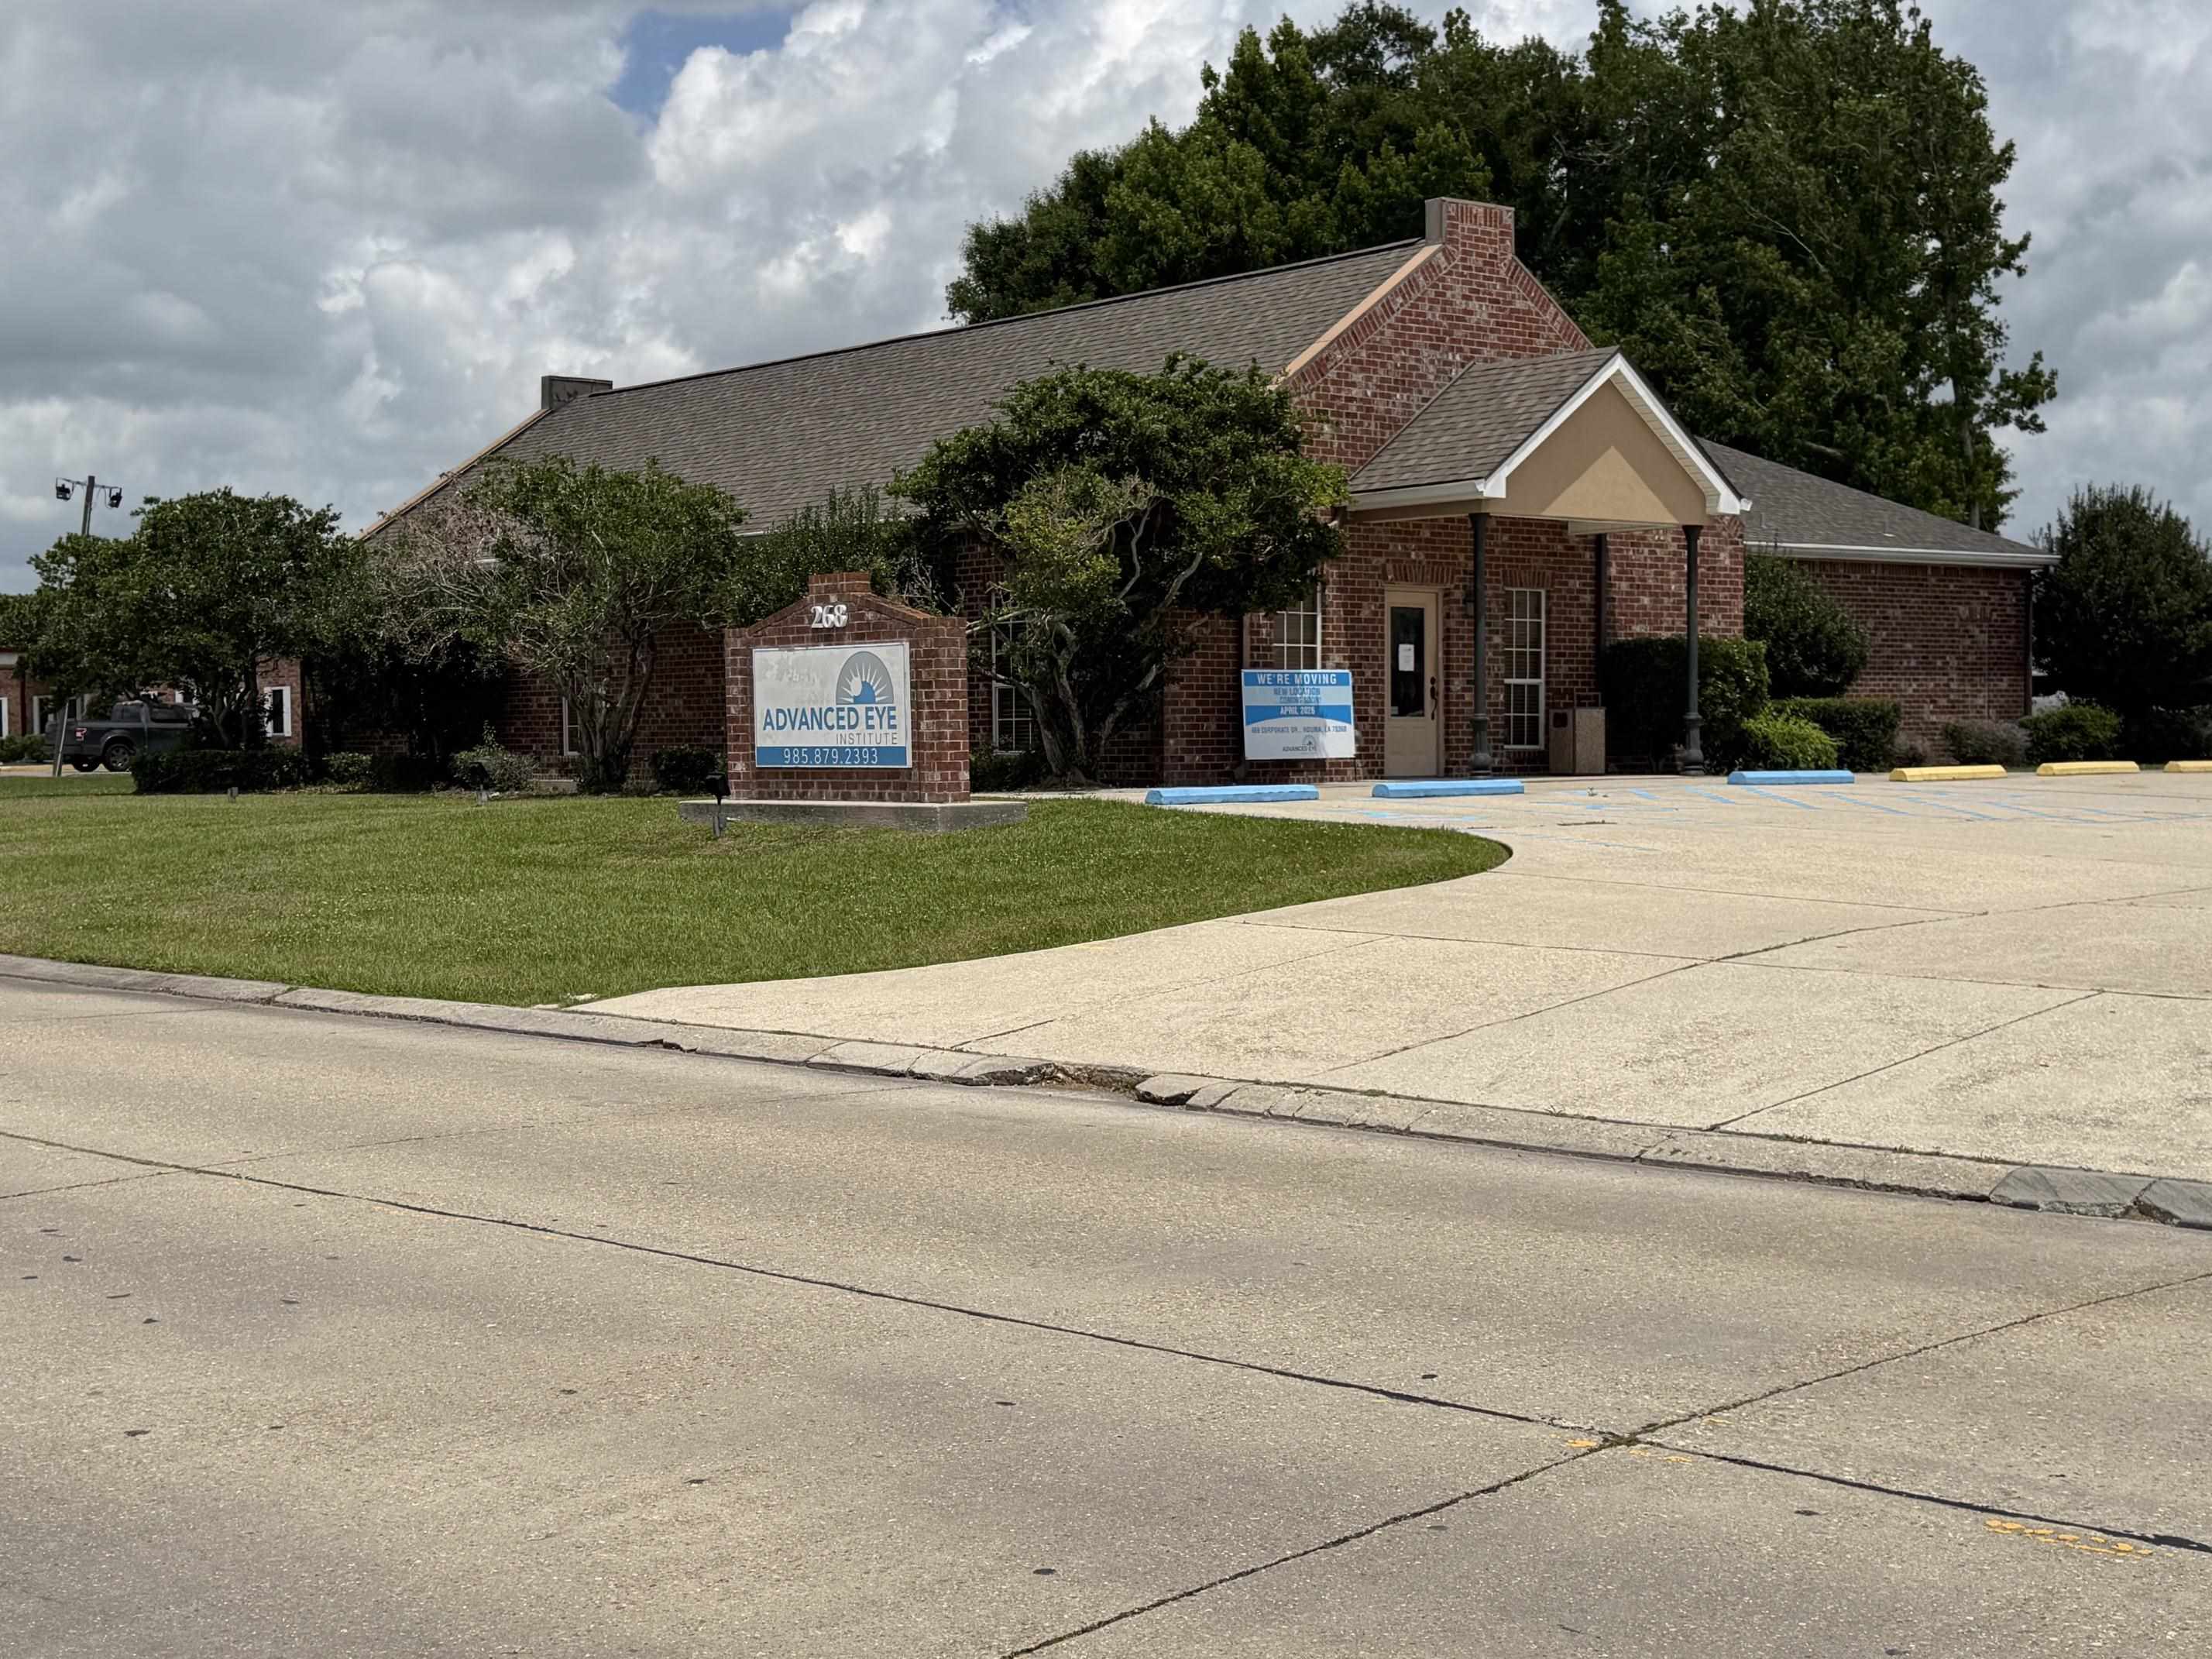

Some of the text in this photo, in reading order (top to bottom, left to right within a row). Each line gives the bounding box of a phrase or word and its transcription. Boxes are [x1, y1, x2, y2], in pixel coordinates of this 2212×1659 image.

[810, 604, 848, 628] 268
[1257, 673, 1337, 685] WE'RE MOVING
[763, 706, 898, 731] ADVANCED EYE
[836, 733, 898, 745] INSTITUTE
[783, 747, 878, 764] 985.879.2393
